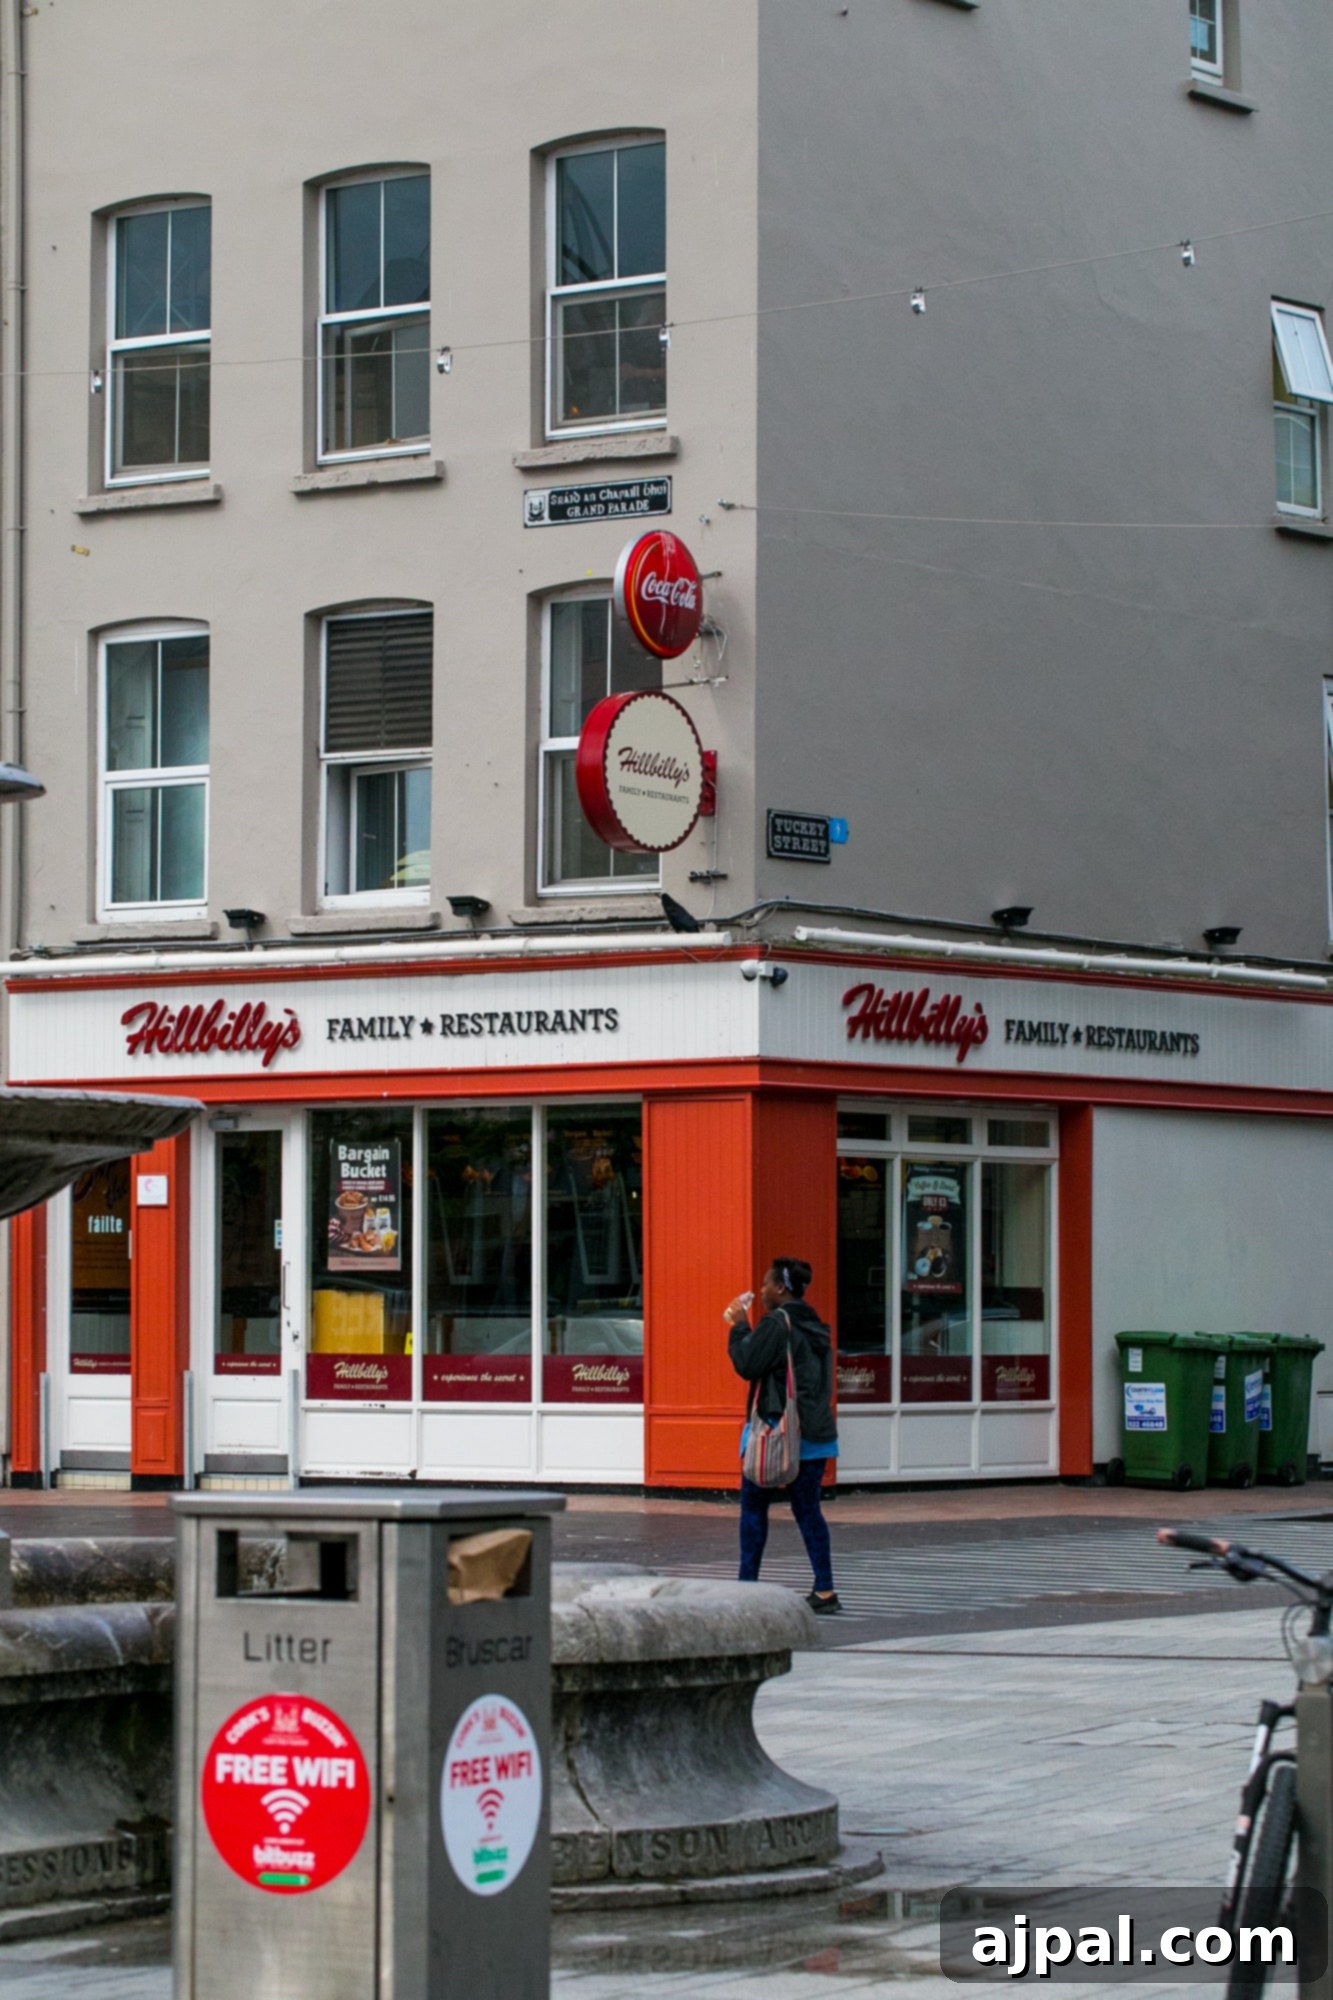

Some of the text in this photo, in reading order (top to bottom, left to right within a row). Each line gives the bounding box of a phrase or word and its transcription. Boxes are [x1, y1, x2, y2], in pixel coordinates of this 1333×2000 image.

[566, 499, 650, 518] GRAND PARADE
[584, 493, 596, 502] an
[617, 746, 690, 789] Hillbilly's
[774, 818, 827, 838] TUCKEY
[774, 835, 827, 854] STREET
[121, 998, 619, 1069] Hillbilly's FAMILY RESTAURANTS
[842, 982, 1200, 1064] Hillbilly's FAMILY RESTAURANTS
[338, 1144, 390, 1163] Bargain
[341, 1162, 387, 1178] Bucket
[333, 1360, 389, 1383] Hillbilly's
[480, 1371, 493, 1382] the
[571, 1363, 630, 1386] Hillbilly's
[242, 1631, 331, 1665] Litter
[445, 1635, 533, 1669] Bruscar
[215, 1752, 356, 1790] FREE WIFI
[450, 1749, 534, 1790] FREE WIFI
